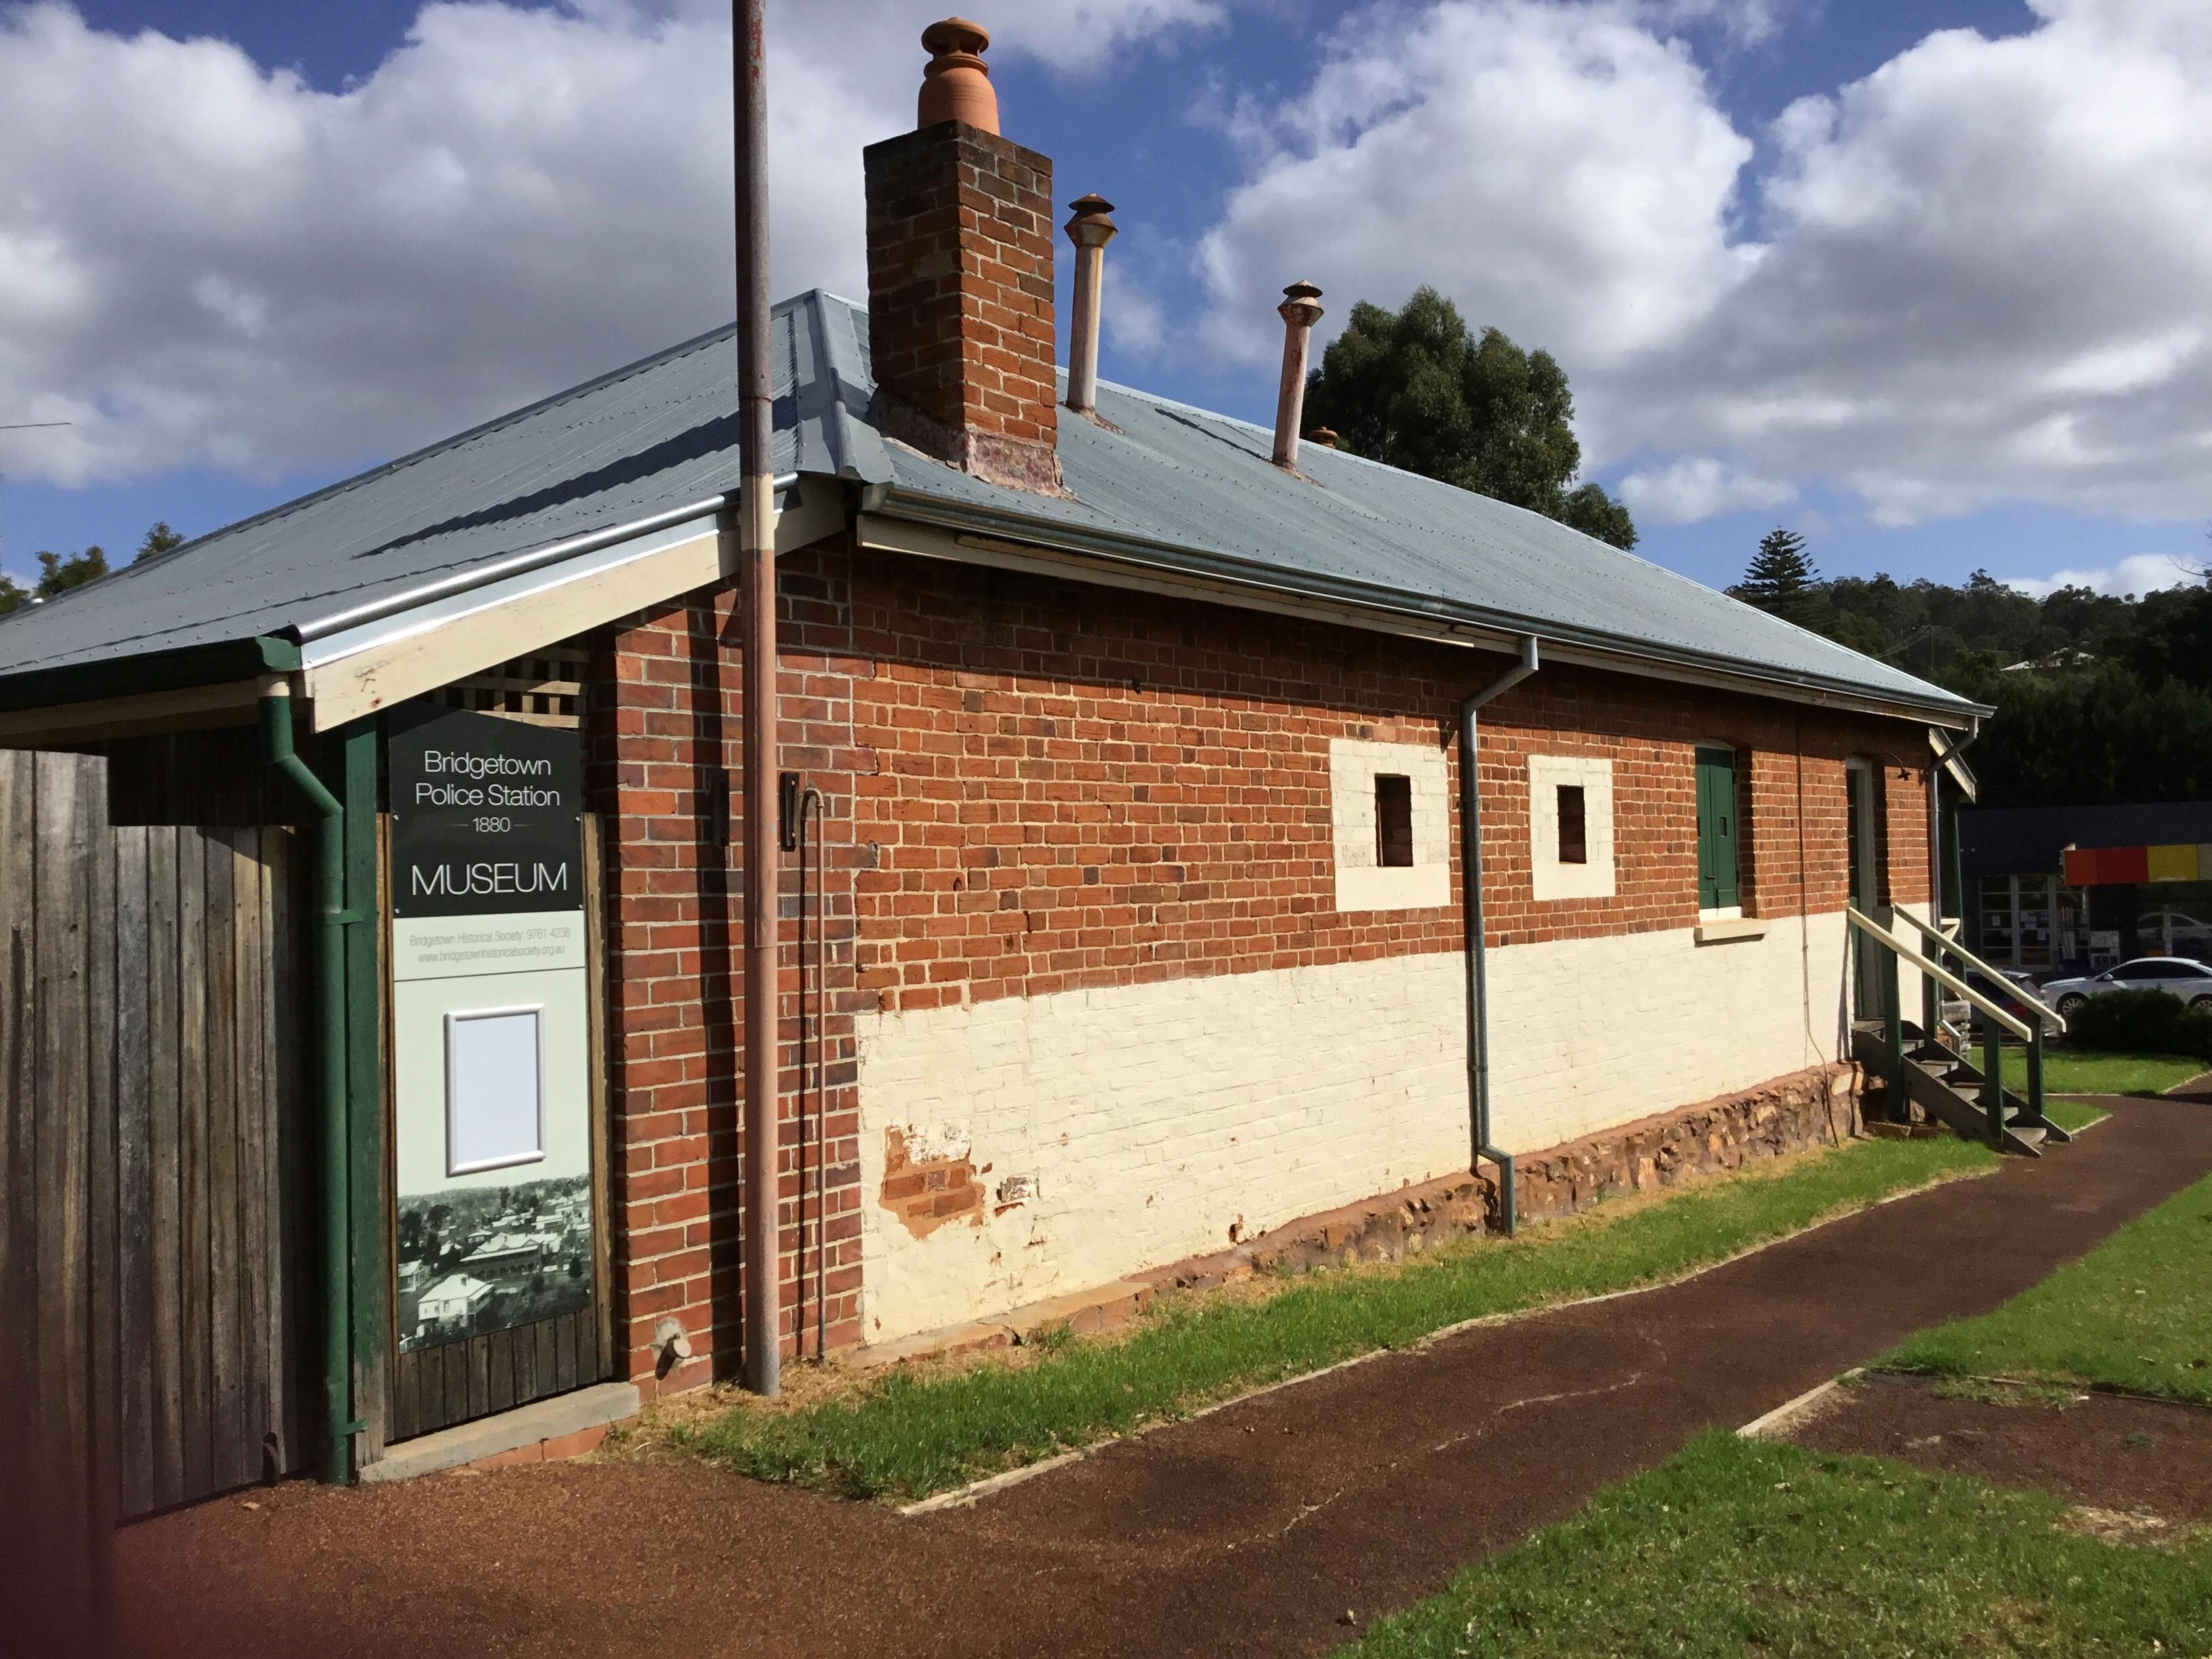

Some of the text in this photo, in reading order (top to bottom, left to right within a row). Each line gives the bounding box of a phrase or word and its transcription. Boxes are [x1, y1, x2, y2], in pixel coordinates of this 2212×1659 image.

[425, 750, 551, 779] Bridgetown
[415, 783, 560, 806] Police Station
[472, 817, 510, 832] 1880
[412, 862, 567, 896] MUSEUM
[409, 935, 455, 948] Bridgetown
[457, 931, 493, 944] Historical
[527, 928, 547, 940] 9761
[550, 927, 571, 939] 4236
[417, 945, 565, 963] www.bridgetownhistoricalsociety.org.au
